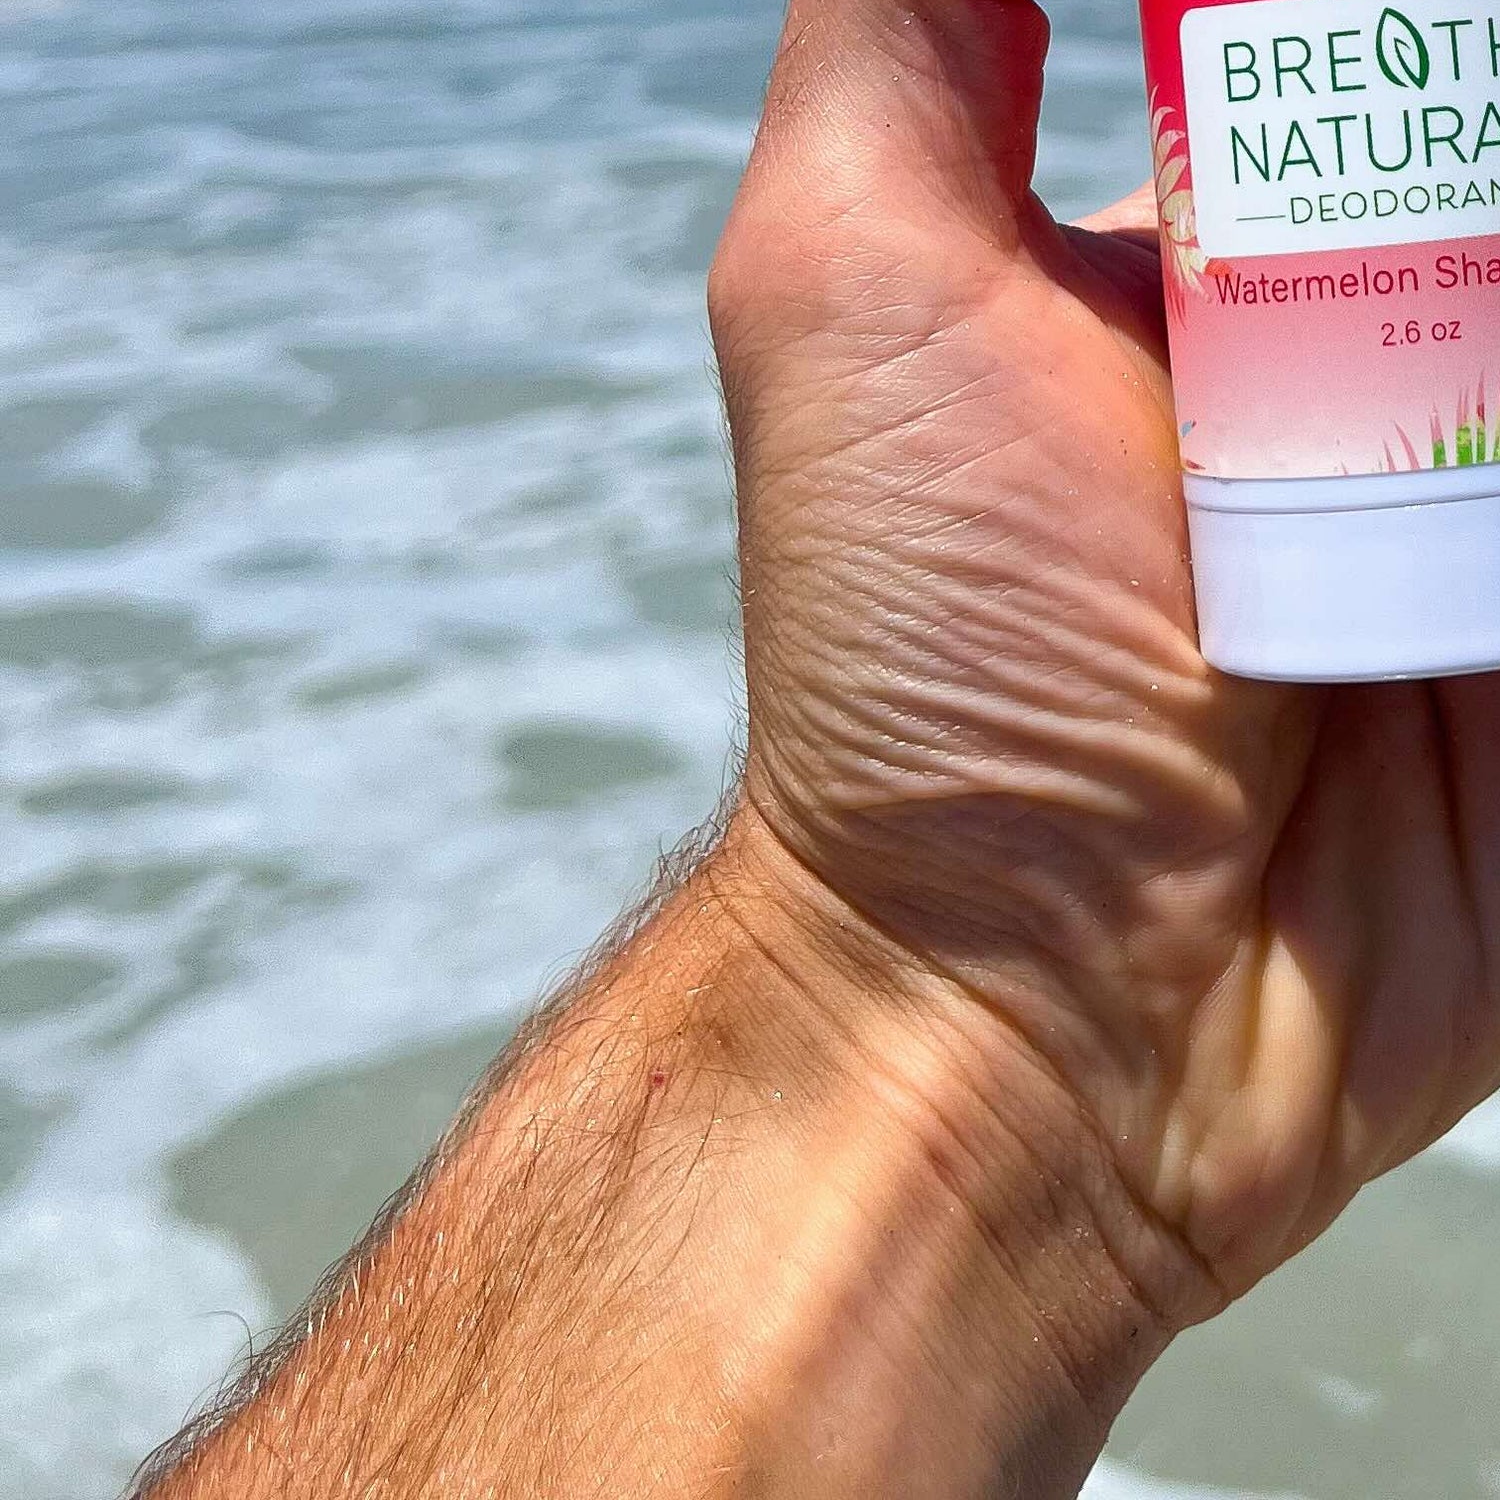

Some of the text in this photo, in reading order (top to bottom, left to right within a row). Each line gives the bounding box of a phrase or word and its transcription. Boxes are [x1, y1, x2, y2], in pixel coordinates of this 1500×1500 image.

[1215, 261, 1419, 306] Watermelon
[1380, 320, 1463, 348] 2.6 oz
